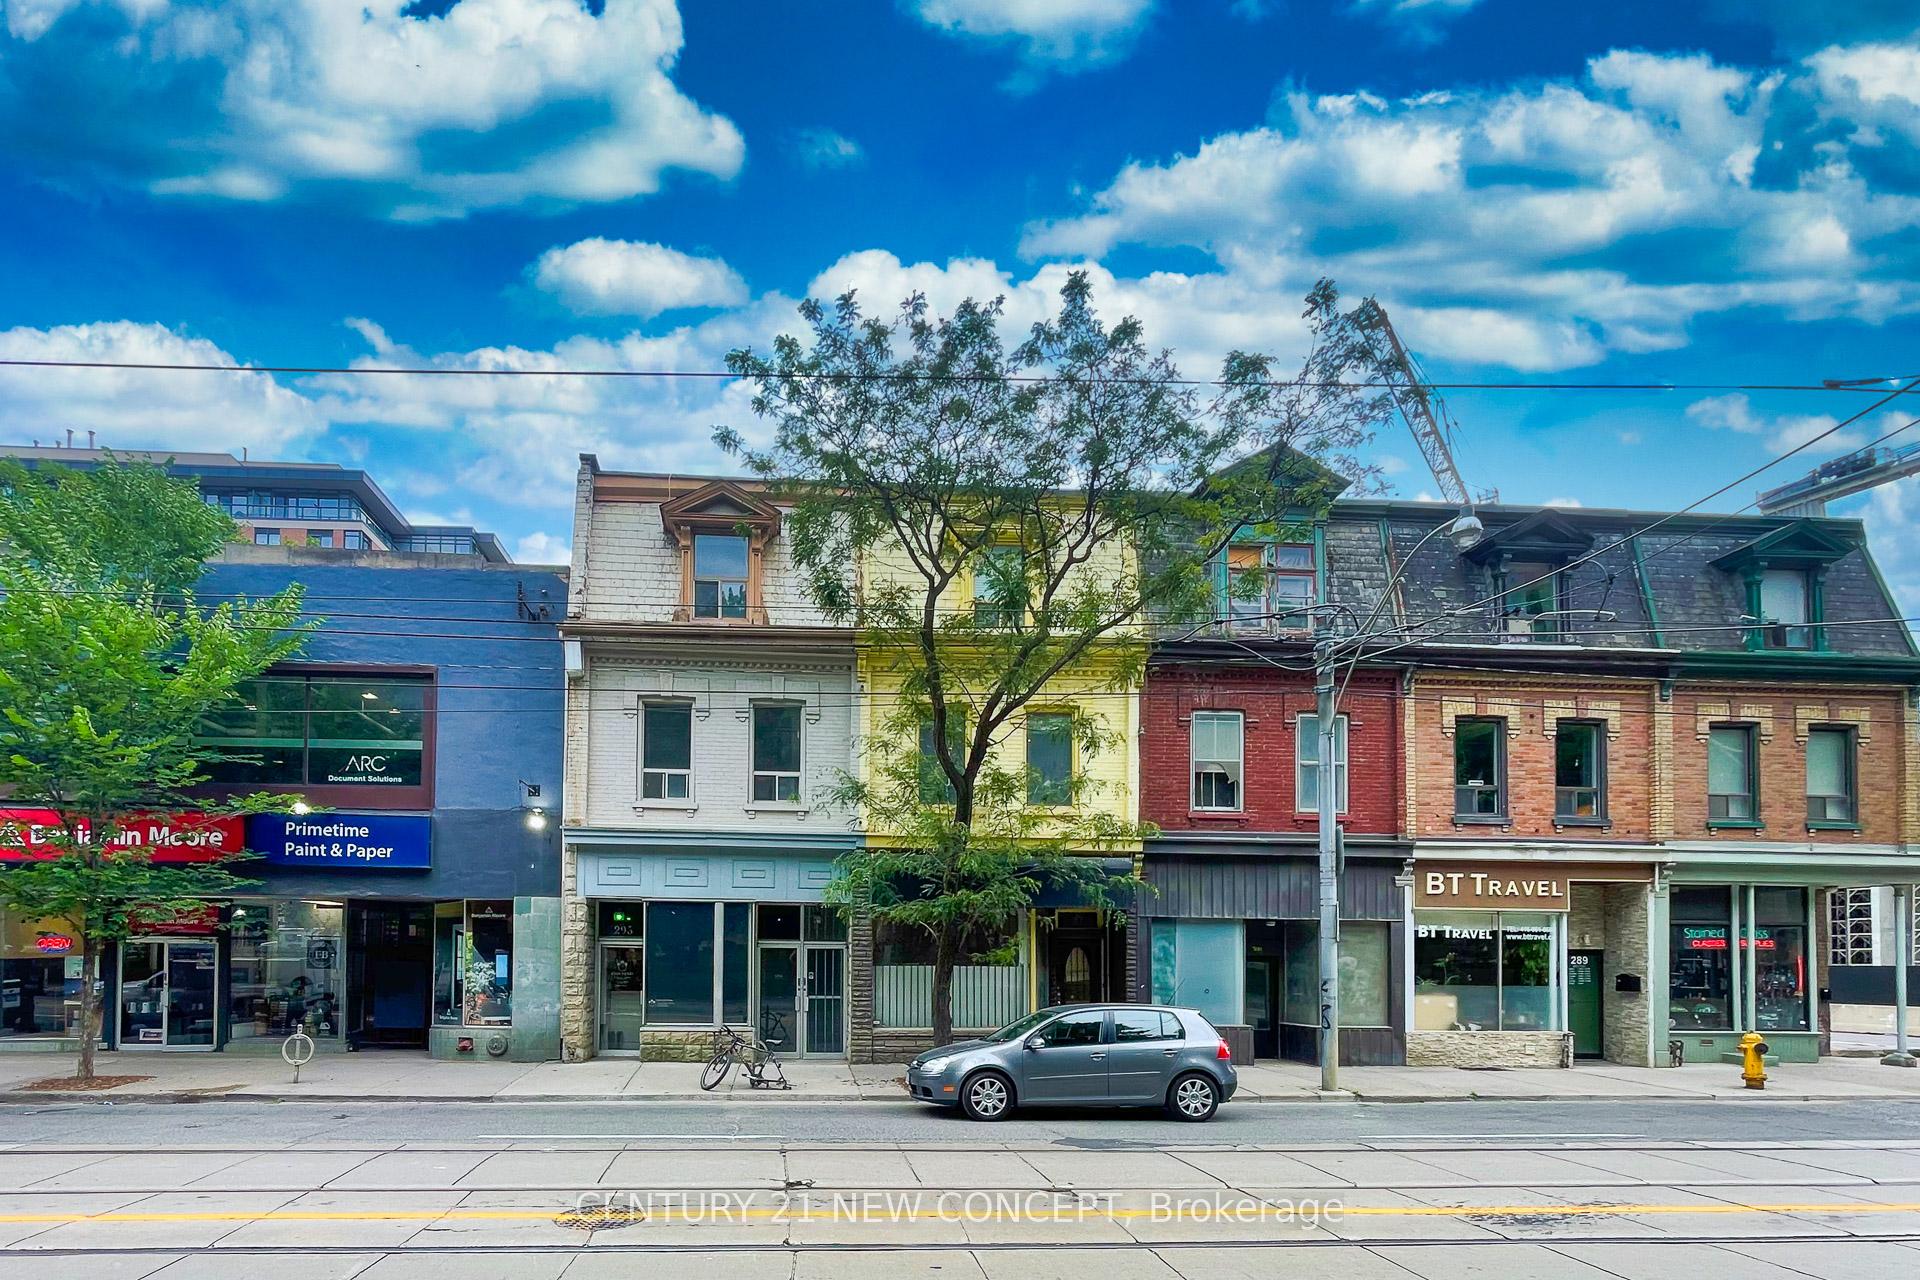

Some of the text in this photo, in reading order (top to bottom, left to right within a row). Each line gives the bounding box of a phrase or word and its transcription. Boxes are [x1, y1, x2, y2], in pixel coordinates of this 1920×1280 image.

[345, 755, 386, 771] ARC
[367, 775, 402, 783] Solutions
[285, 822, 369, 837] Primetime
[285, 842, 394, 861] Paint & Paper
[1426, 872, 1563, 896] BT TRAVEL
[1418, 925, 1492, 940] BT TRAVEL
[37, 938, 71, 949] OPEN
[1570, 956, 1589, 965] 289
